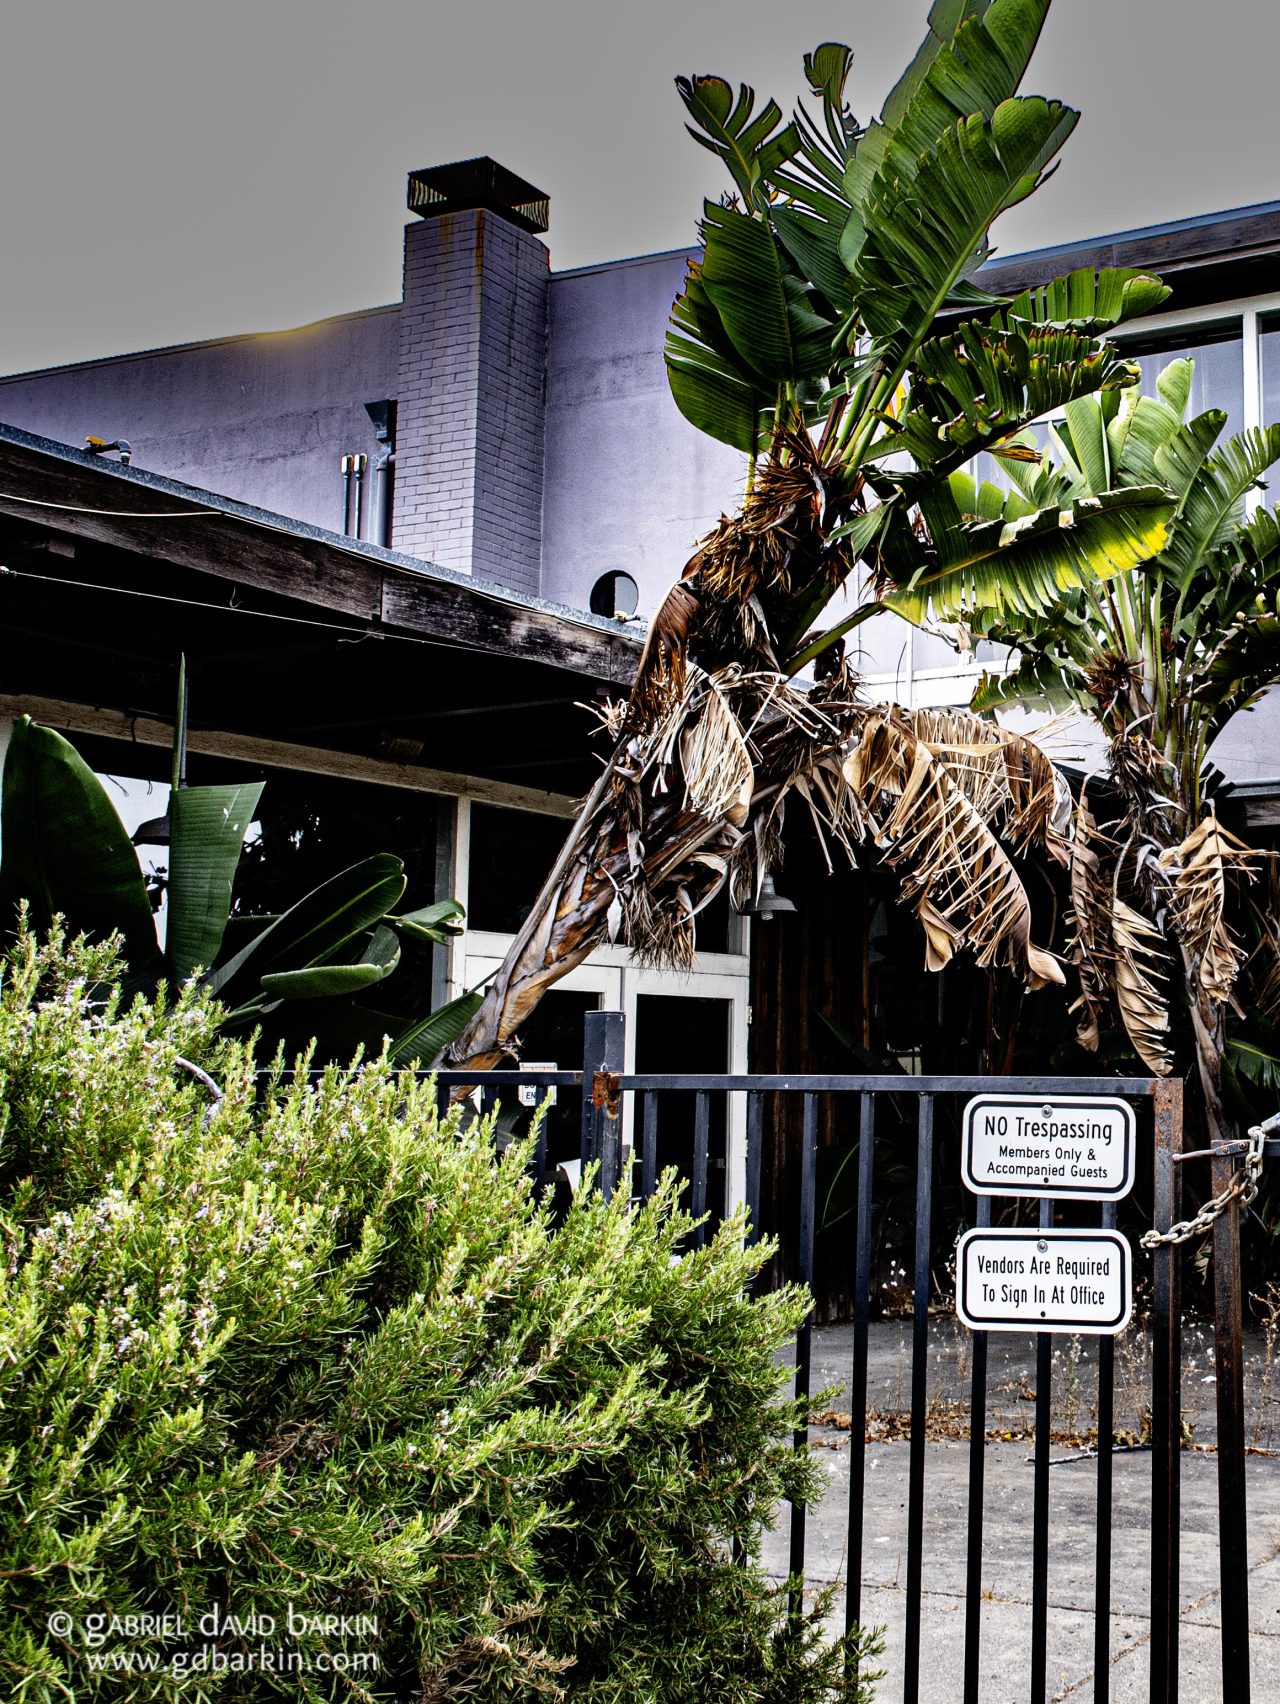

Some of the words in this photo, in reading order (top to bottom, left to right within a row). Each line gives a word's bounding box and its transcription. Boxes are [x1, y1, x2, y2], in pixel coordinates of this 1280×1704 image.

[985, 1115, 1008, 1136] NO
[1016, 1117, 1112, 1145] Trespassing
[999, 1145, 1050, 1159] Members
[1055, 1147, 1081, 1162] Only
[1087, 1149, 1096, 1161] &
[987, 1161, 1065, 1178] Accompanied
[1071, 1166, 1108, 1178] Guests
[978, 1255, 1024, 1274] Vendors
[1030, 1256, 1050, 1275] Are
[1057, 1257, 1110, 1279] Required
[982, 1283, 995, 1302] To
[1001, 1284, 1027, 1308] Sign
[1034, 1285, 1045, 1303] In
[1051, 1285, 1064, 1304] At
[1070, 1286, 1105, 1305] Office
